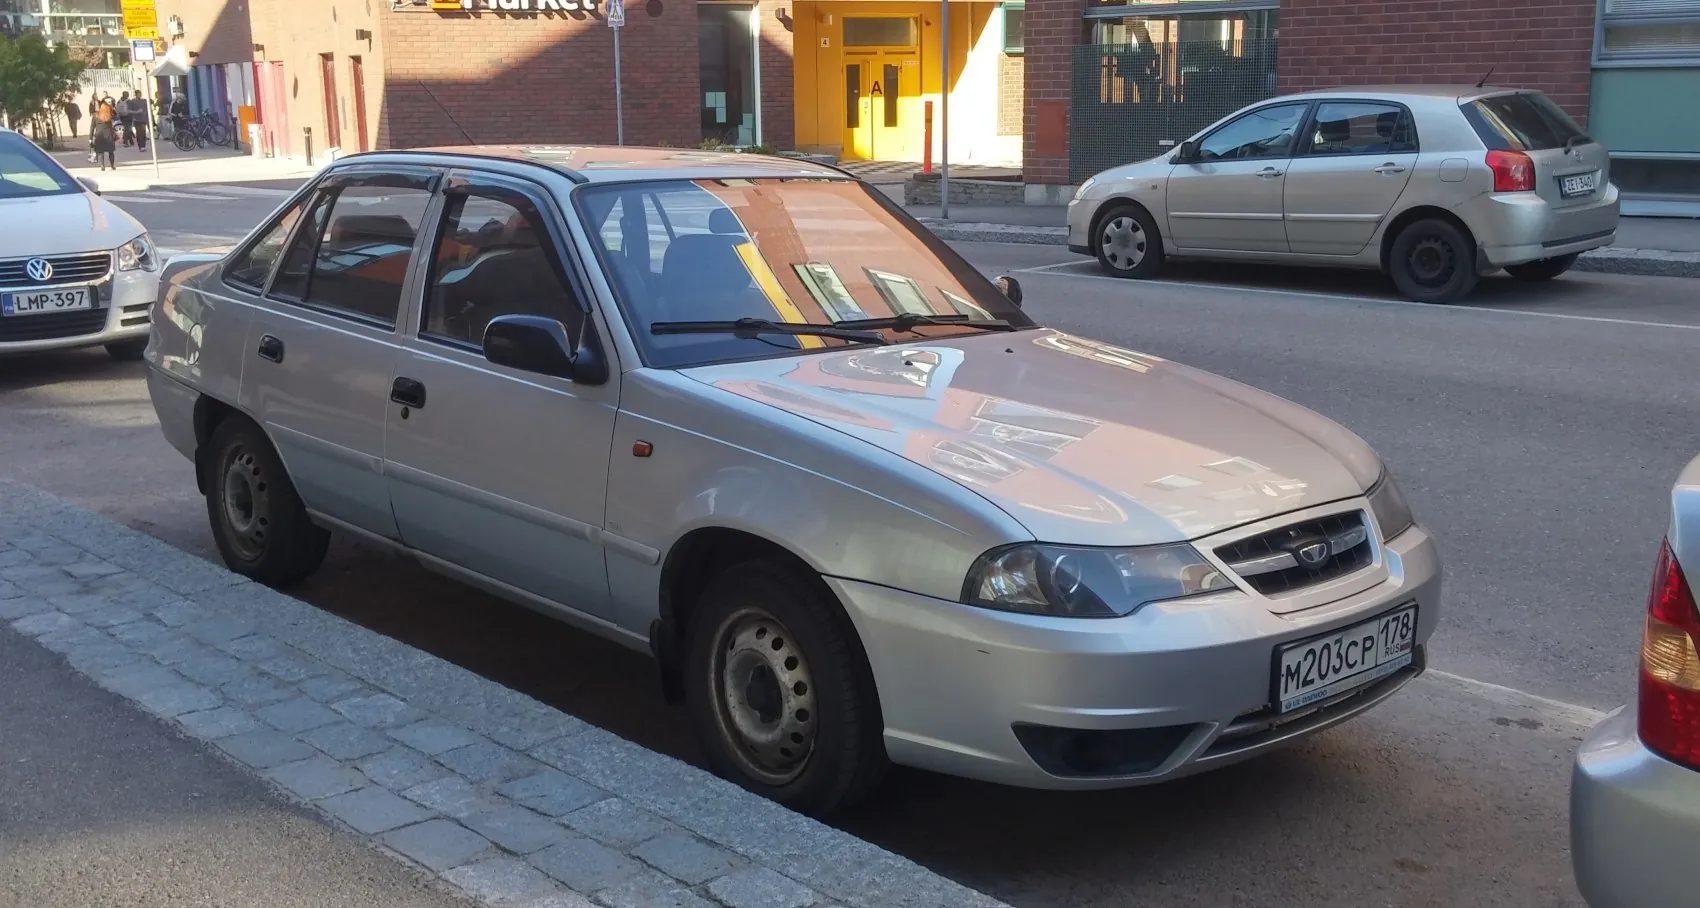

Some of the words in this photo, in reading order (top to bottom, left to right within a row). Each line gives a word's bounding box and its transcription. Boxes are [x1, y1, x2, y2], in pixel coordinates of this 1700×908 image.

[871, 80, 883, 95] A
[16, 291, 84, 311] LMP-397
[1284, 635, 1375, 694] M203CP
[1380, 612, 1410, 647] 178
[1384, 643, 1400, 657] RUS
